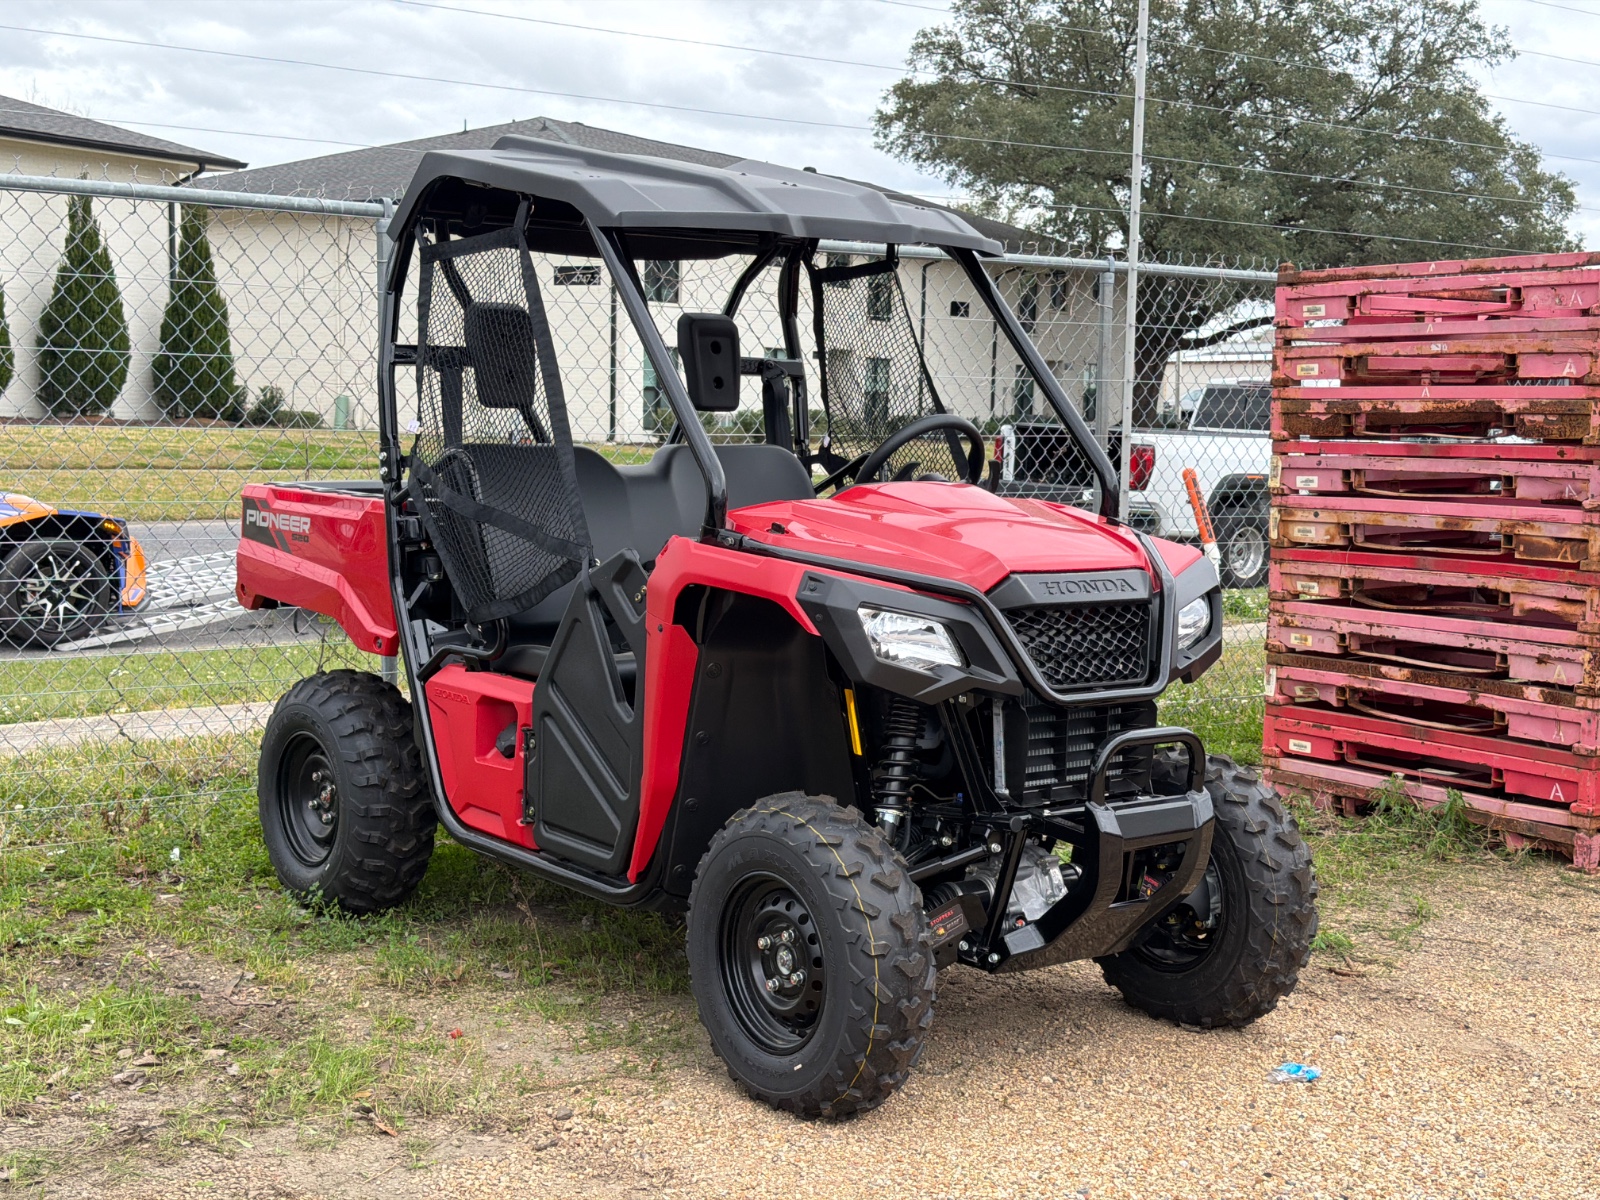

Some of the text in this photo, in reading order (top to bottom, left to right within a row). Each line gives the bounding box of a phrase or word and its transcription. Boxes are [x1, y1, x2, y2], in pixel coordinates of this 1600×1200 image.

[1568, 289, 1583, 308] A
[1562, 358, 1577, 377] A
[1421, 387, 1431, 399] A
[245, 509, 311, 534] PIONEER
[292, 533, 309, 543] 520
[1039, 578, 1137, 595] HONDA
[1553, 664, 1567, 683] A
[434, 687, 471, 706] HONDA
[1549, 782, 1565, 802] A
